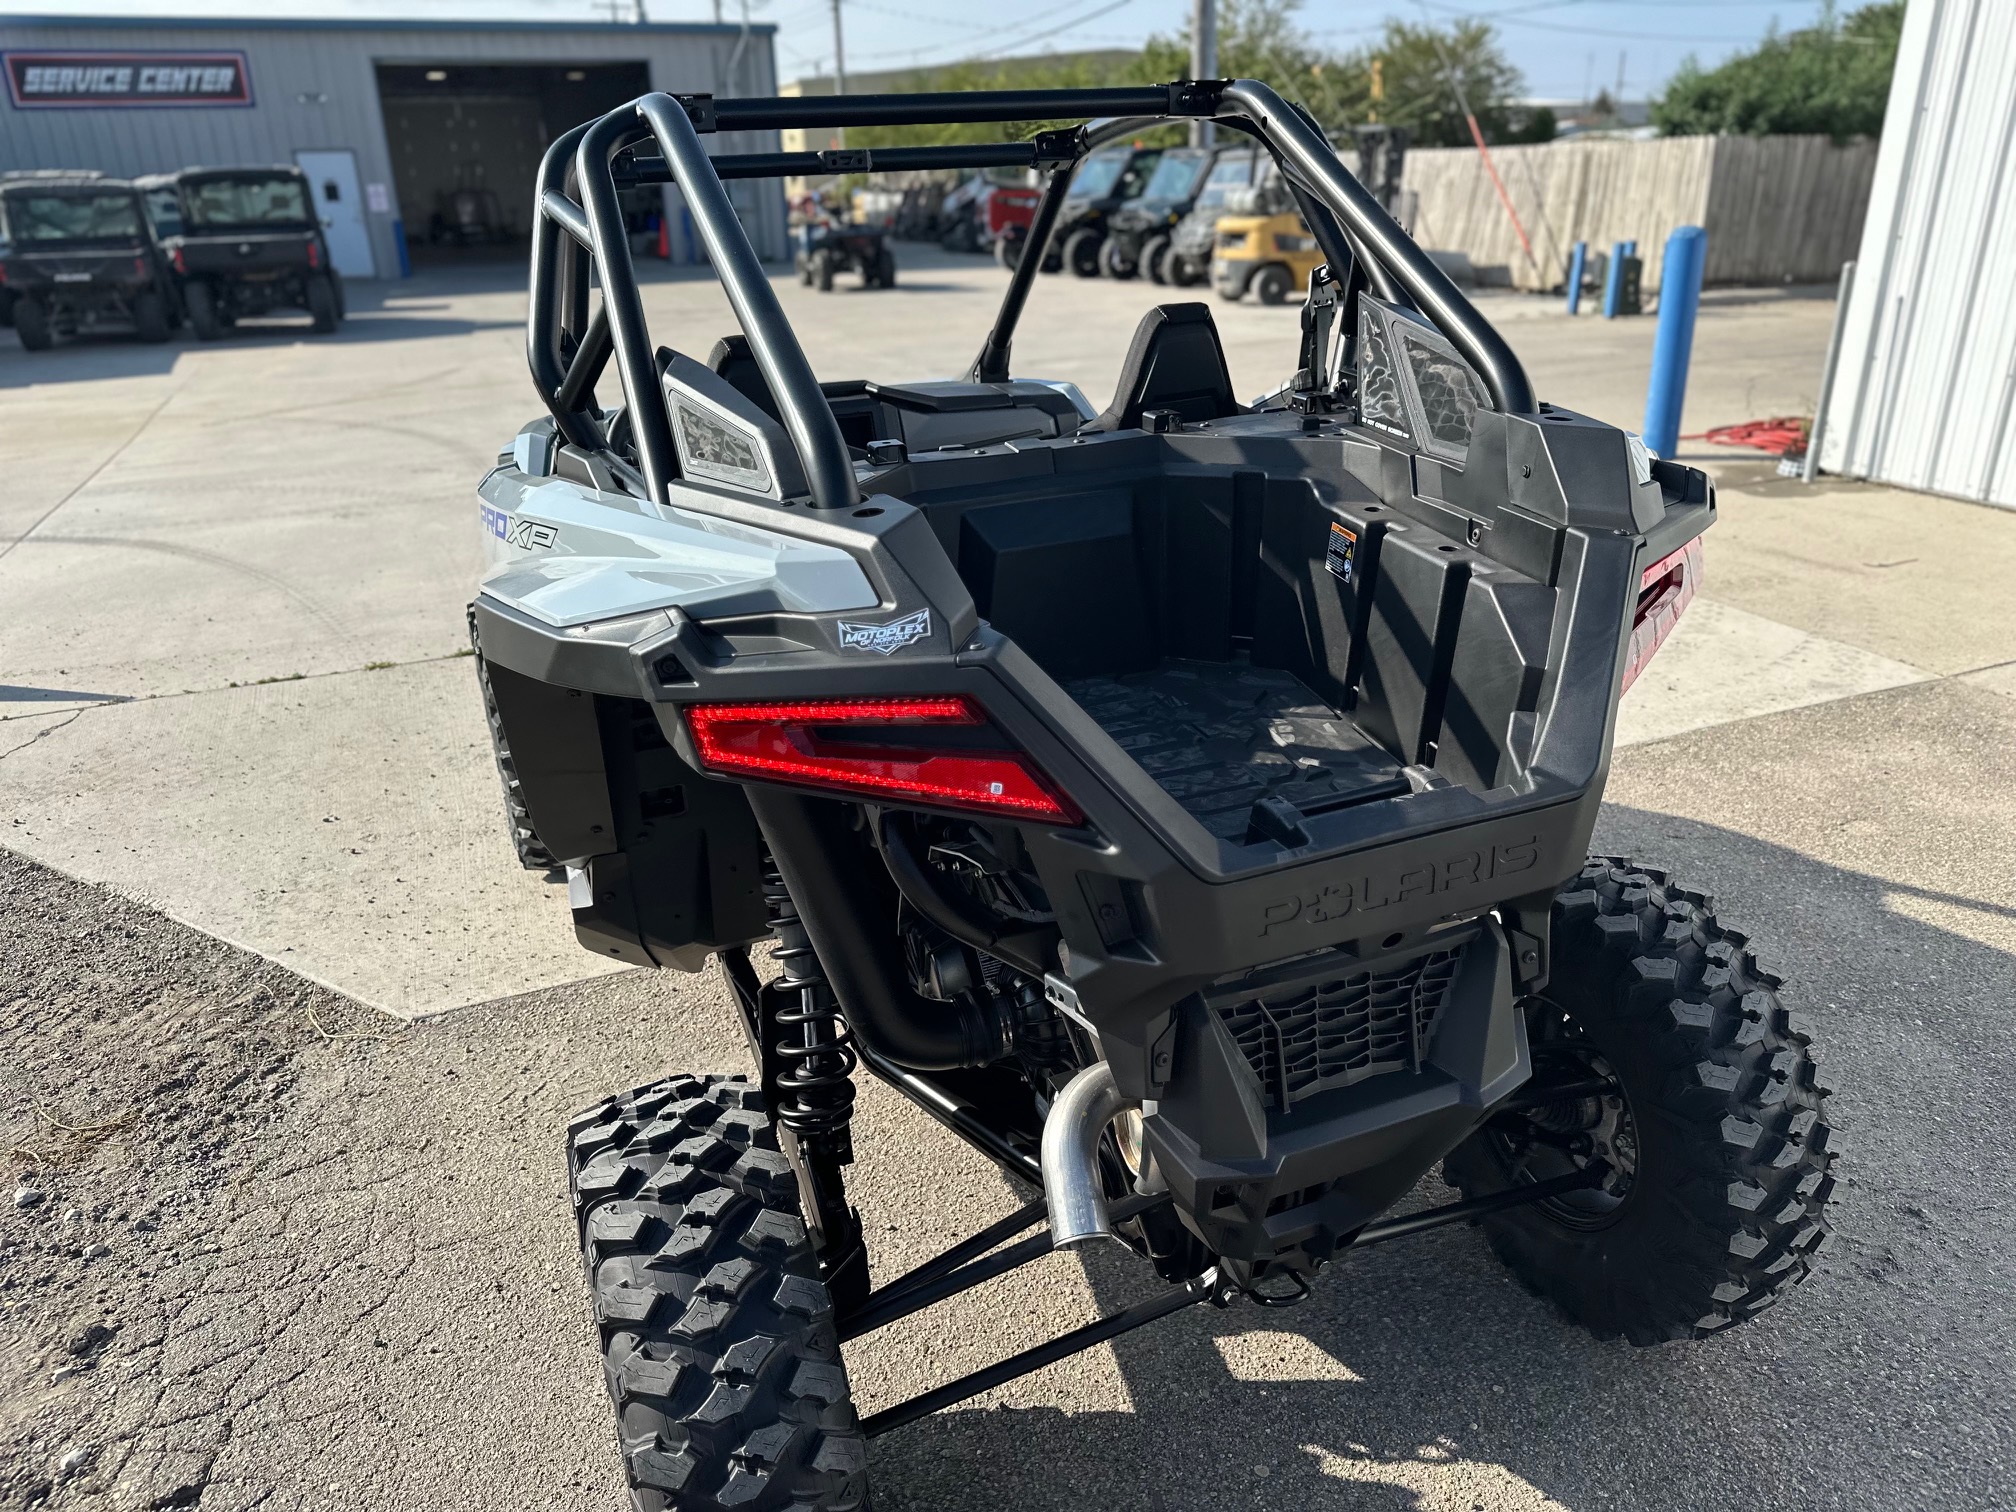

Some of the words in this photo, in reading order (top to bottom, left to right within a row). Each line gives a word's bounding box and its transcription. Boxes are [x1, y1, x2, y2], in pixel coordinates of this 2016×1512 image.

[23, 66, 133, 92] SERVICE
[137, 66, 236, 92] CENTER
[845, 623, 925, 643] MOTOPLEX
[873, 633, 910, 644] NORFOLK
[1257, 835, 1542, 937] POLARIS
